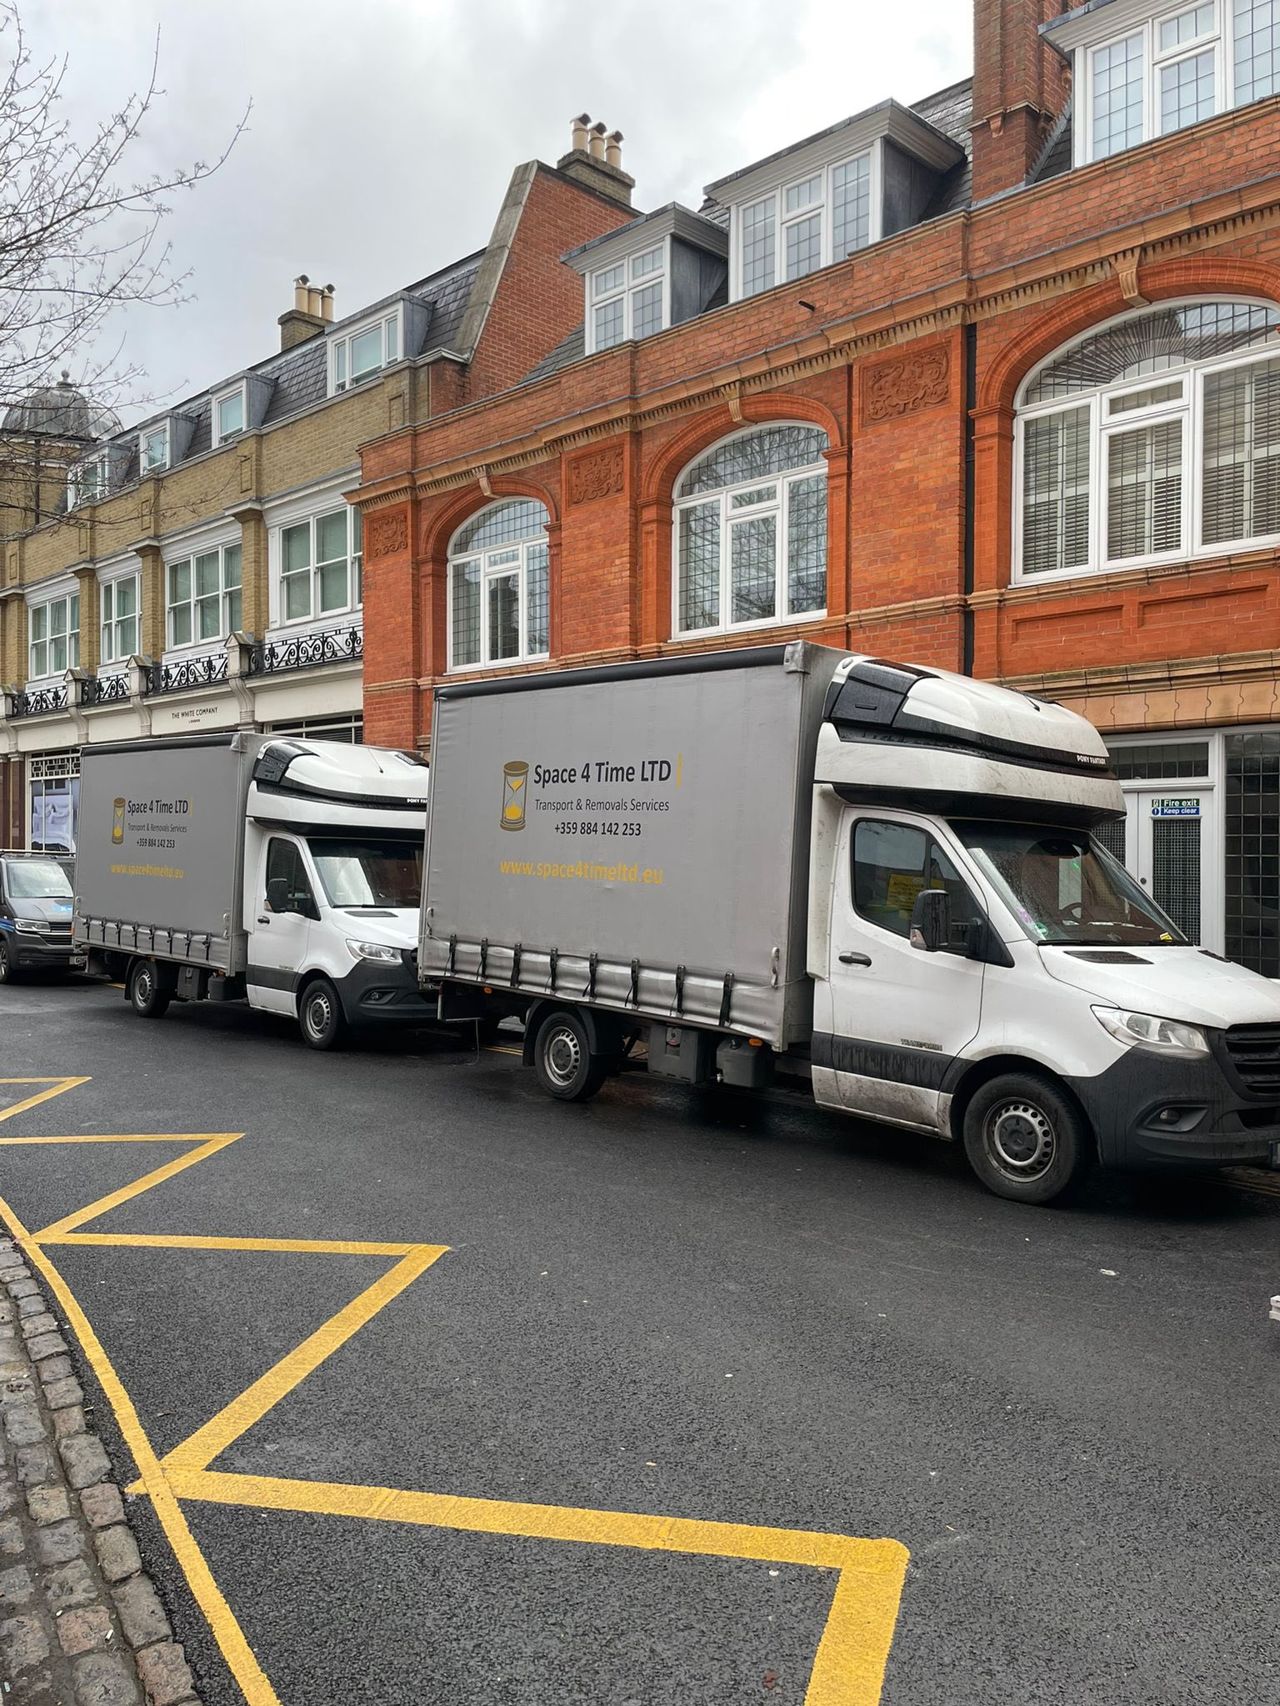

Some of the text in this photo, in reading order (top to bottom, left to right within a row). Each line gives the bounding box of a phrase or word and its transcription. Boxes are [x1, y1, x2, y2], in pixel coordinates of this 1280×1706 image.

[195, 706, 218, 716] COMPANY
[534, 760, 672, 789] Space 4 Time LTD
[127, 799, 189, 816] Space 4 Time LTD
[535, 798, 670, 813] Transport & Removals Services
[128, 823, 146, 832] Transport
[150, 823, 169, 832] Removals
[169, 824, 187, 833] Services
[554, 822, 642, 836] +359 884 142 253
[136, 838, 148, 847] +359
[157, 839, 166, 848] 142
[166, 839, 176, 849] 253
[500, 860, 664, 885] www.space4timeltd.eu
